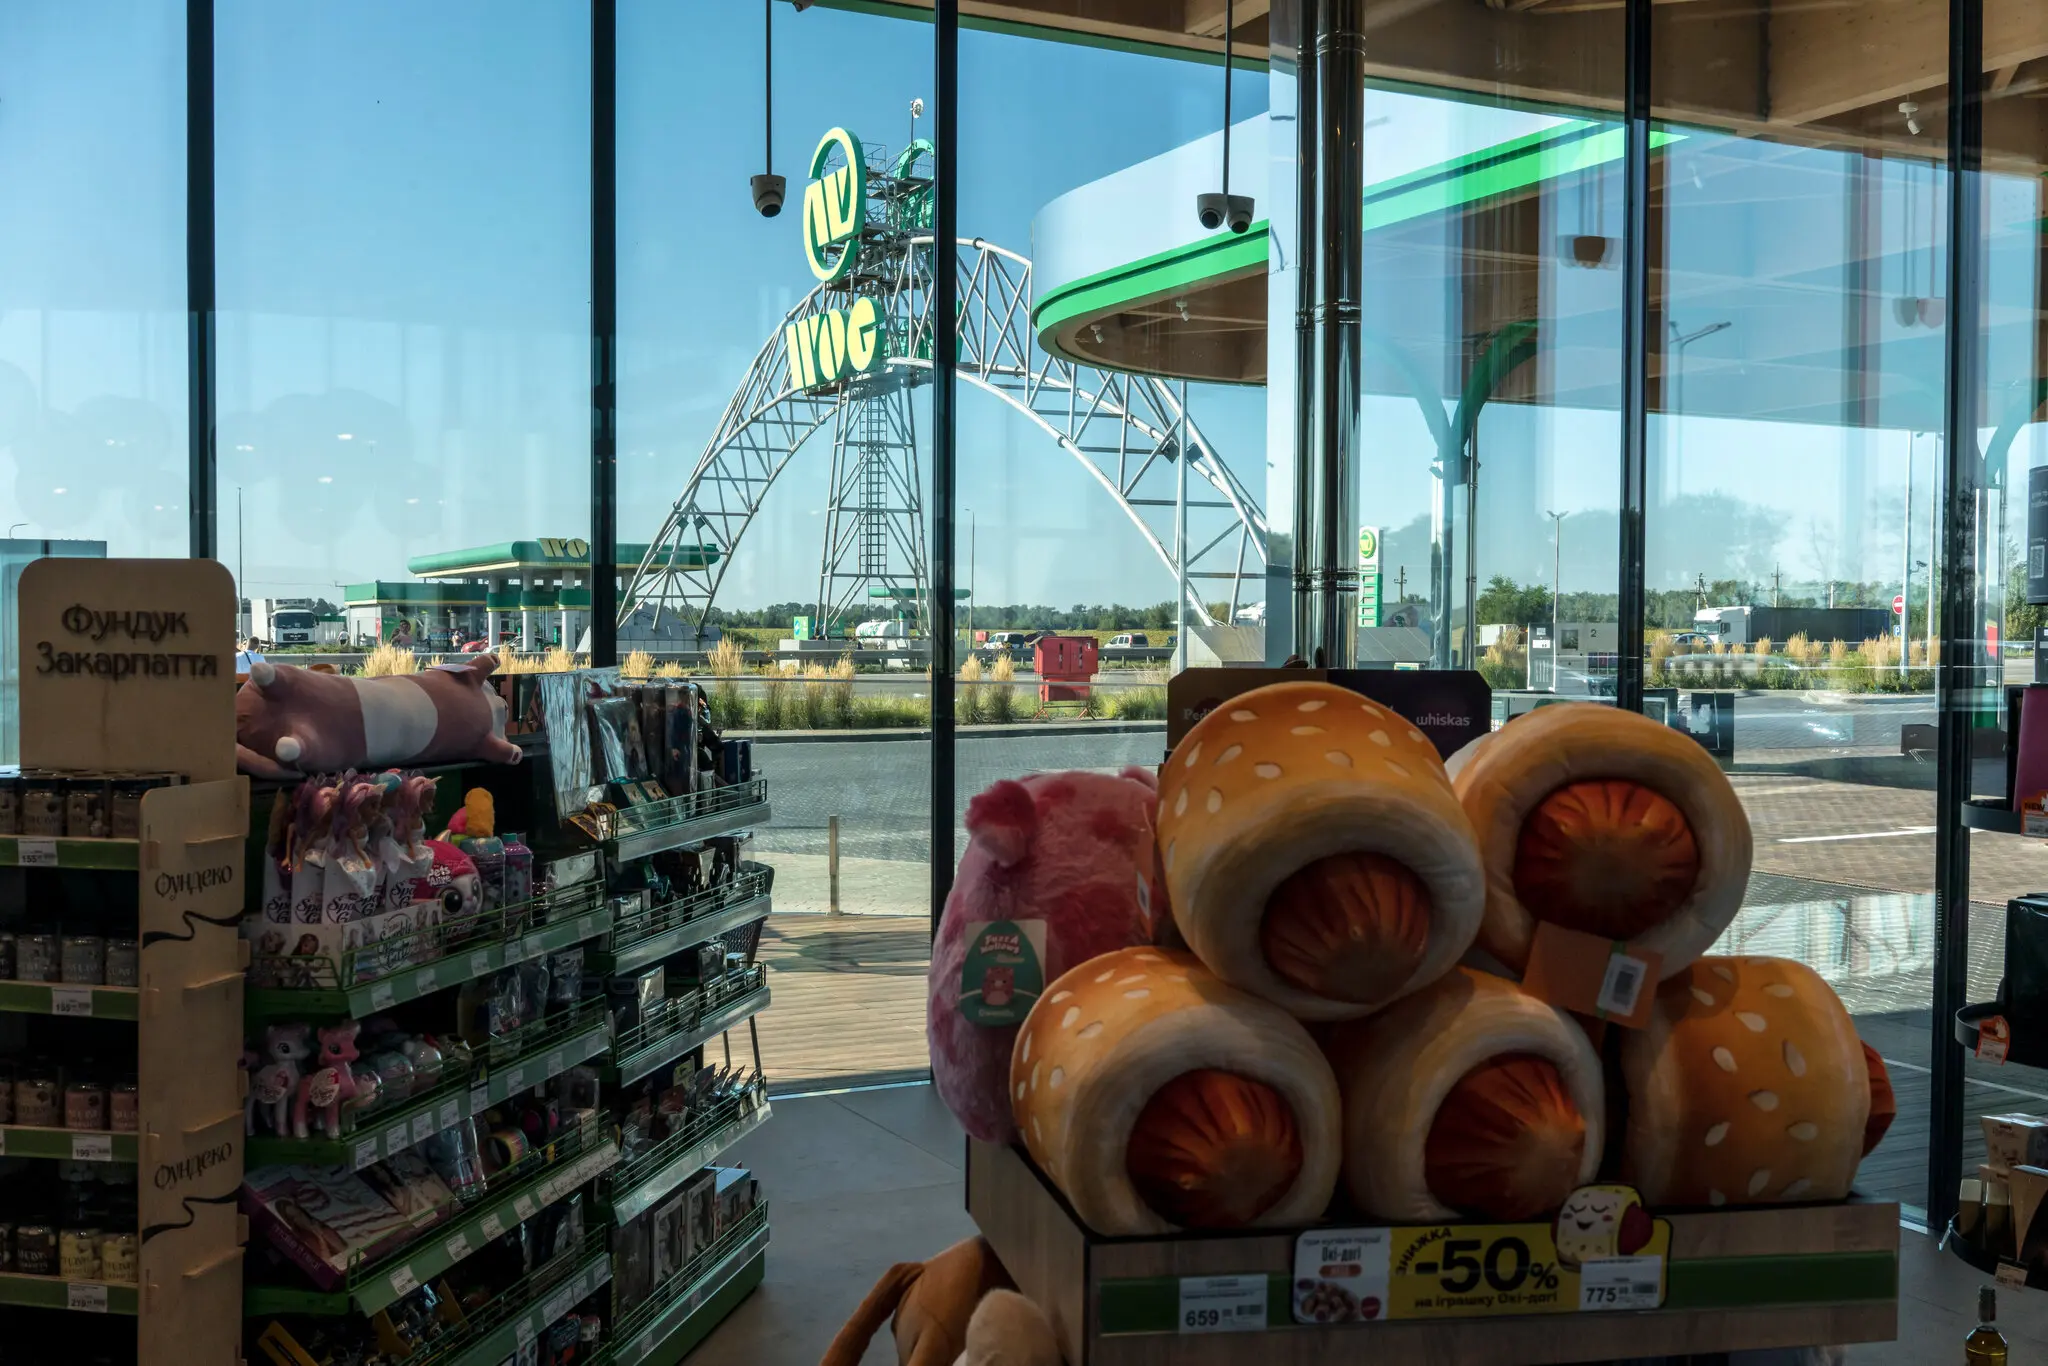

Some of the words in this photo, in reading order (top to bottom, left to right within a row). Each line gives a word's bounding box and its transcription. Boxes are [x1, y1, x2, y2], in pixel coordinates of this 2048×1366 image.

[62, 603, 190, 642] Фундук
[36, 641, 218, 681] Закарпаття
[1415, 711, 1471, 728] whiskas
[154, 864, 233, 901] Фундеко
[154, 1141, 233, 1190] Фундеко
[1322, 1245, 1362, 1262] Окі-догі
[1395, 1227, 1452, 1275] ЗНИЖКА
[1415, 1236, 1558, 1293] -50%
[1415, 1297, 1432, 1308] на
[1436, 1295, 1494, 1308] іграшку
[1497, 1291, 1558, 1304] Окі-догі
[1585, 1286, 1617, 1303] 775
[1185, 1308, 1219, 1327] 659
